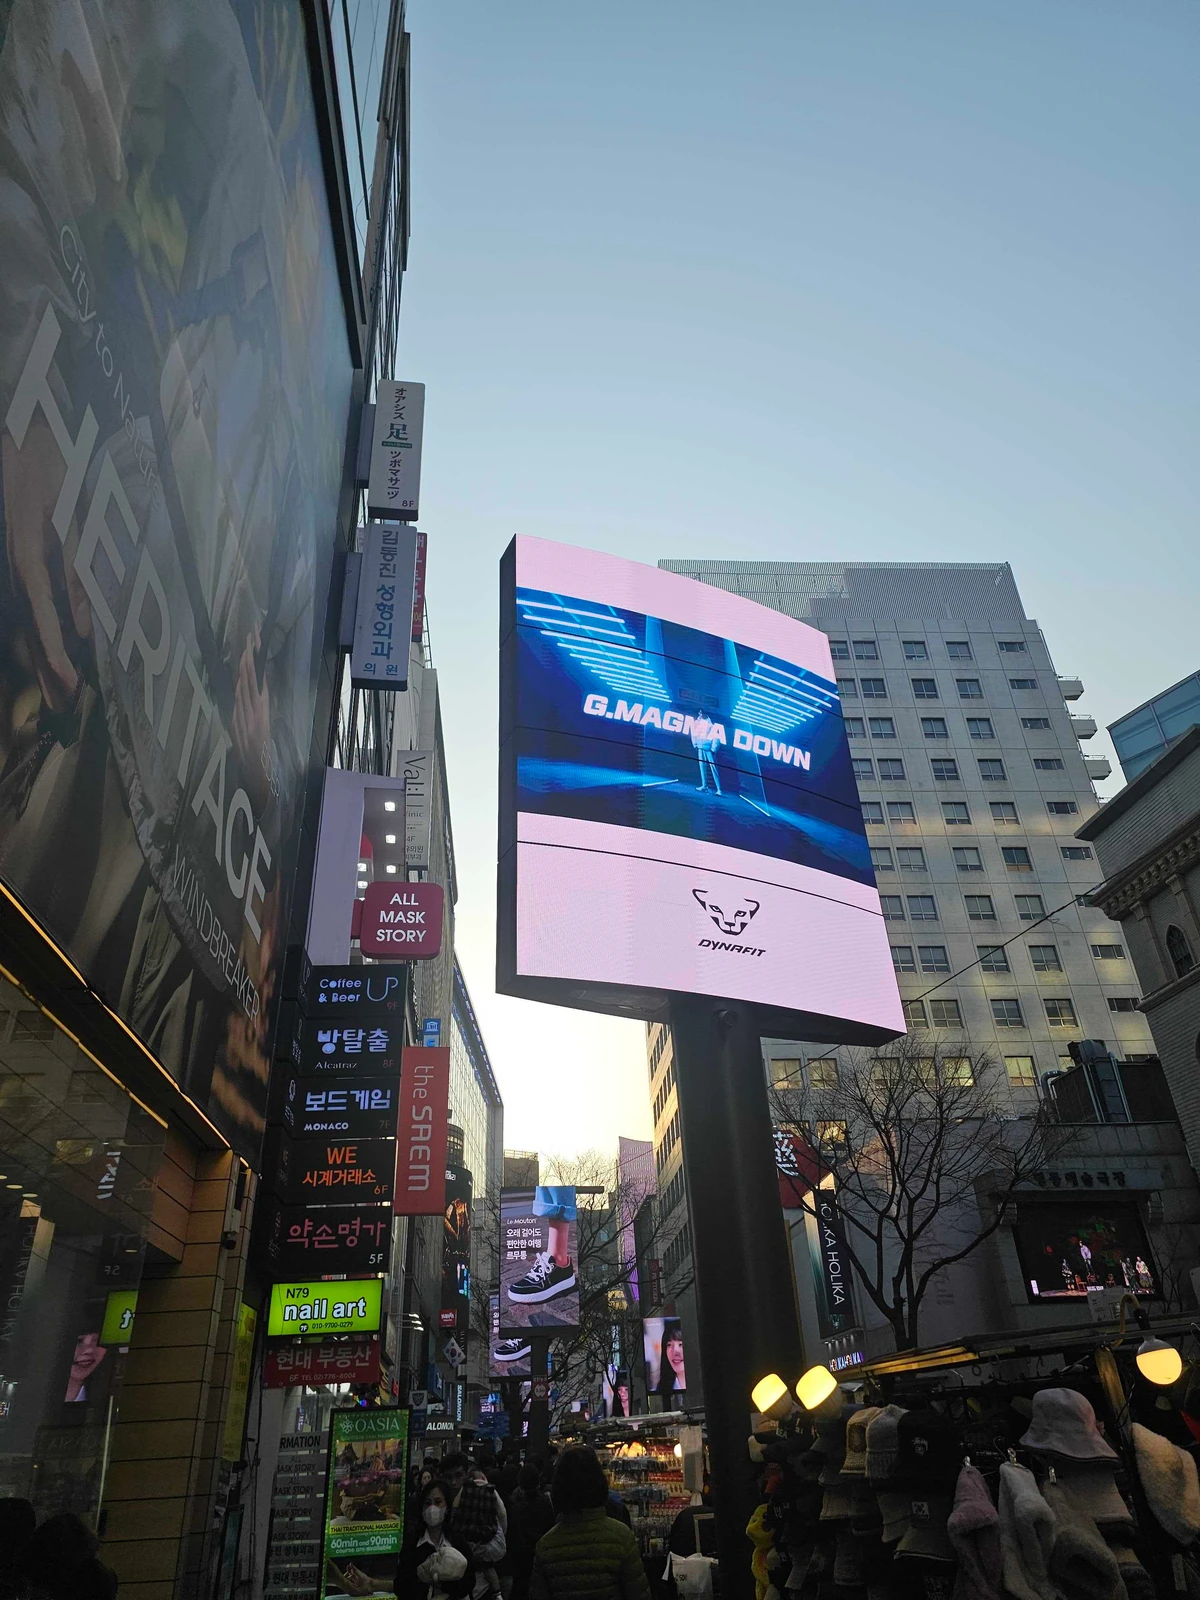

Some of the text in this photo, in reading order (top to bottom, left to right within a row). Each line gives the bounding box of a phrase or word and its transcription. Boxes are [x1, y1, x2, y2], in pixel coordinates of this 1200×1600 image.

[60, 225, 97, 323] City
[96, 322, 114, 377] to
[386, 423, 409, 441] 足
[370, 530, 398, 659] 김동진 성형외과
[583, 693, 811, 770] G.MAGMA DOWN
[389, 893, 419, 905] ALL
[379, 910, 426, 924] MASK
[173, 843, 260, 1029] WINDBREAKER
[375, 929, 427, 943] STORY
[698, 939, 766, 957] DYNAFIT
[319, 979, 361, 989] Coffee
[318, 993, 361, 1003] & Beer
[317, 1028, 390, 1054] 방탈출
[314, 1061, 358, 1070] Alcatraz
[412, 1065, 435, 1099] the
[305, 1089, 392, 1111] 보드게임
[303, 1122, 349, 1131] MONACO
[327, 1146, 358, 1165] WE
[302, 1168, 377, 1187] 시계거래소
[373, 1184, 389, 1195] 6F
[286, 1216, 387, 1248] 약손명가
[506, 1228, 521, 1237] 오래
[506, 1239, 527, 1249] 편안한
[368, 1253, 384, 1264] 5F
[827, 1251, 846, 1305] HOLIKA
[286, 1287, 310, 1299] N79
[284, 1297, 367, 1322] nail art
[276, 1347, 312, 1371] 현대
[317, 1345, 372, 1369] 부동산
[289, 1374, 299, 1382] 6F
[355, 1417, 400, 1433] OASIA
[294, 1464, 316, 1472] STORY
[375, 1522, 399, 1530] MASSAGE
[330, 1537, 359, 1549] 60min
[370, 1534, 398, 1546] 90min
[272, 1570, 316, 1585] 현대 부동산
